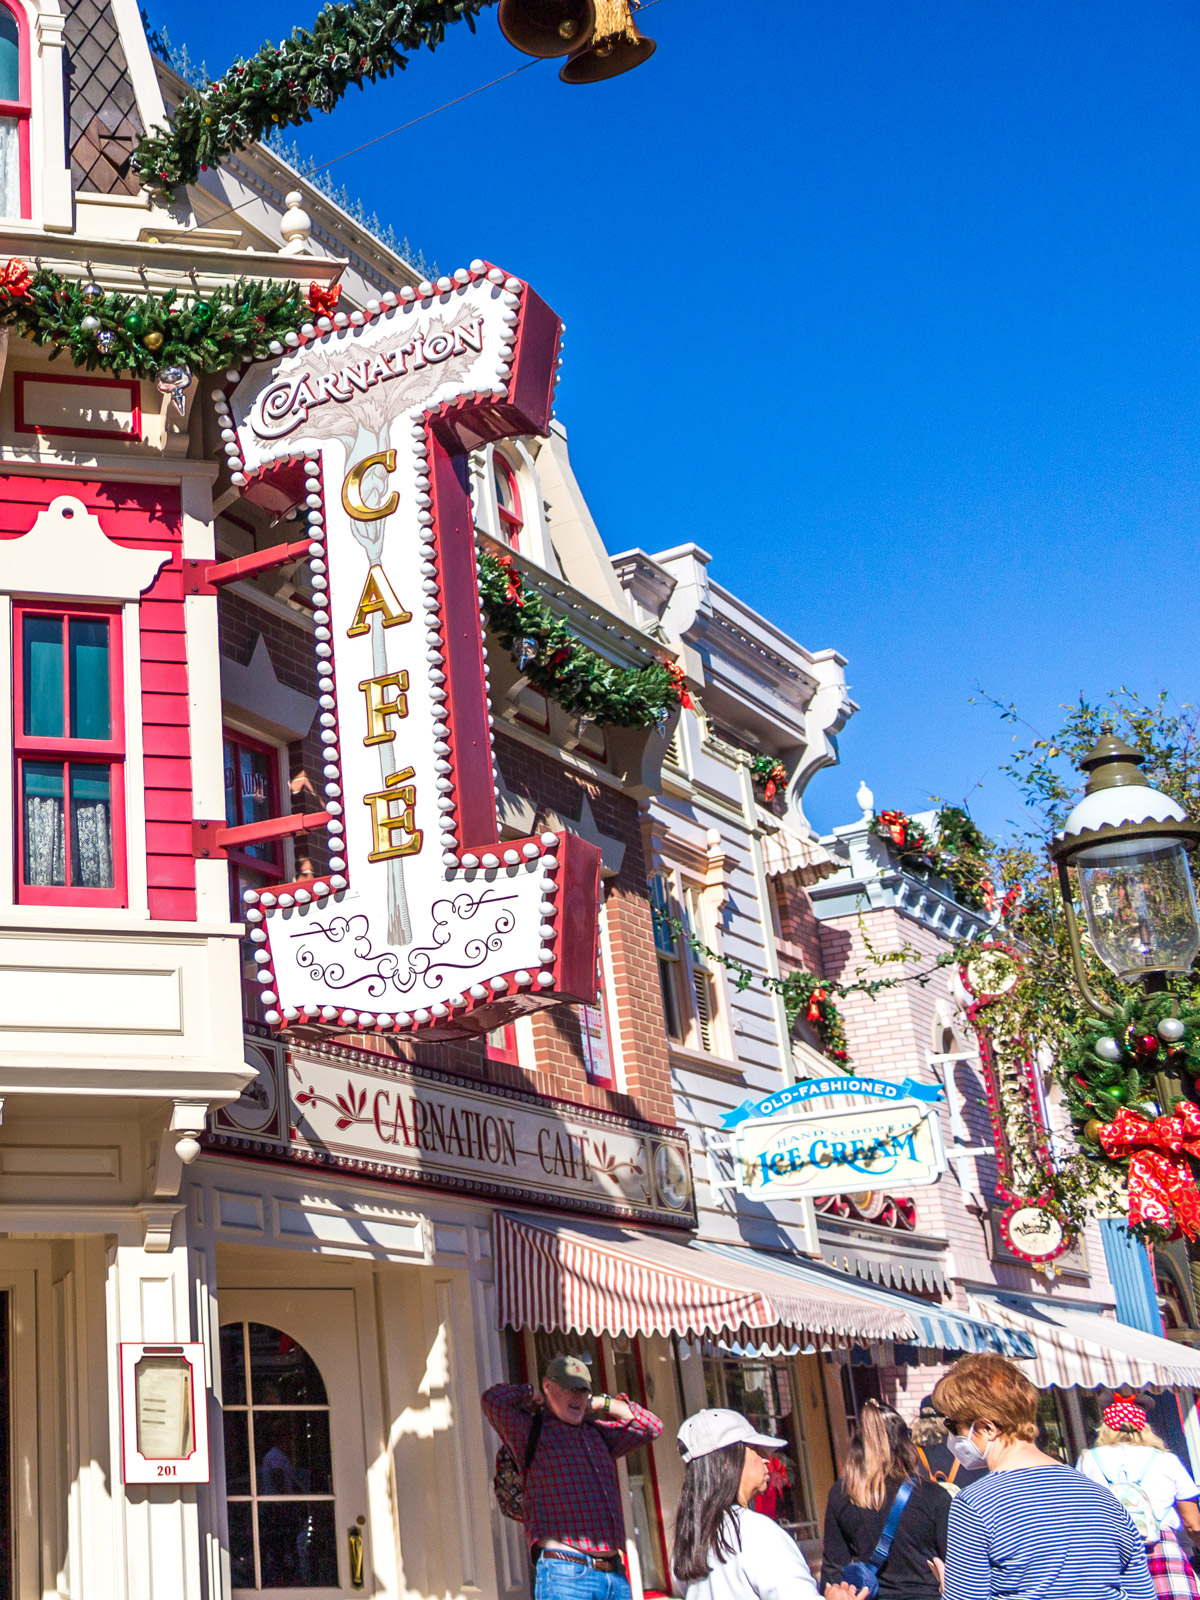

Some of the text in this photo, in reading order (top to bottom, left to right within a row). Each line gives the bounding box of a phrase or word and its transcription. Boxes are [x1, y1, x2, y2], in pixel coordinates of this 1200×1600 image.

[250, 318, 485, 440] CARNATION
[342, 449, 424, 864] CAFÉ
[760, 1080, 897, 1114] OLD-FASHIONED
[373, 1090, 516, 1168] CARNATION
[777, 1122, 913, 1149] HAND SCOOPED
[756, 1133, 921, 1188] ICE CREAM
[157, 1465, 178, 1477] 201
